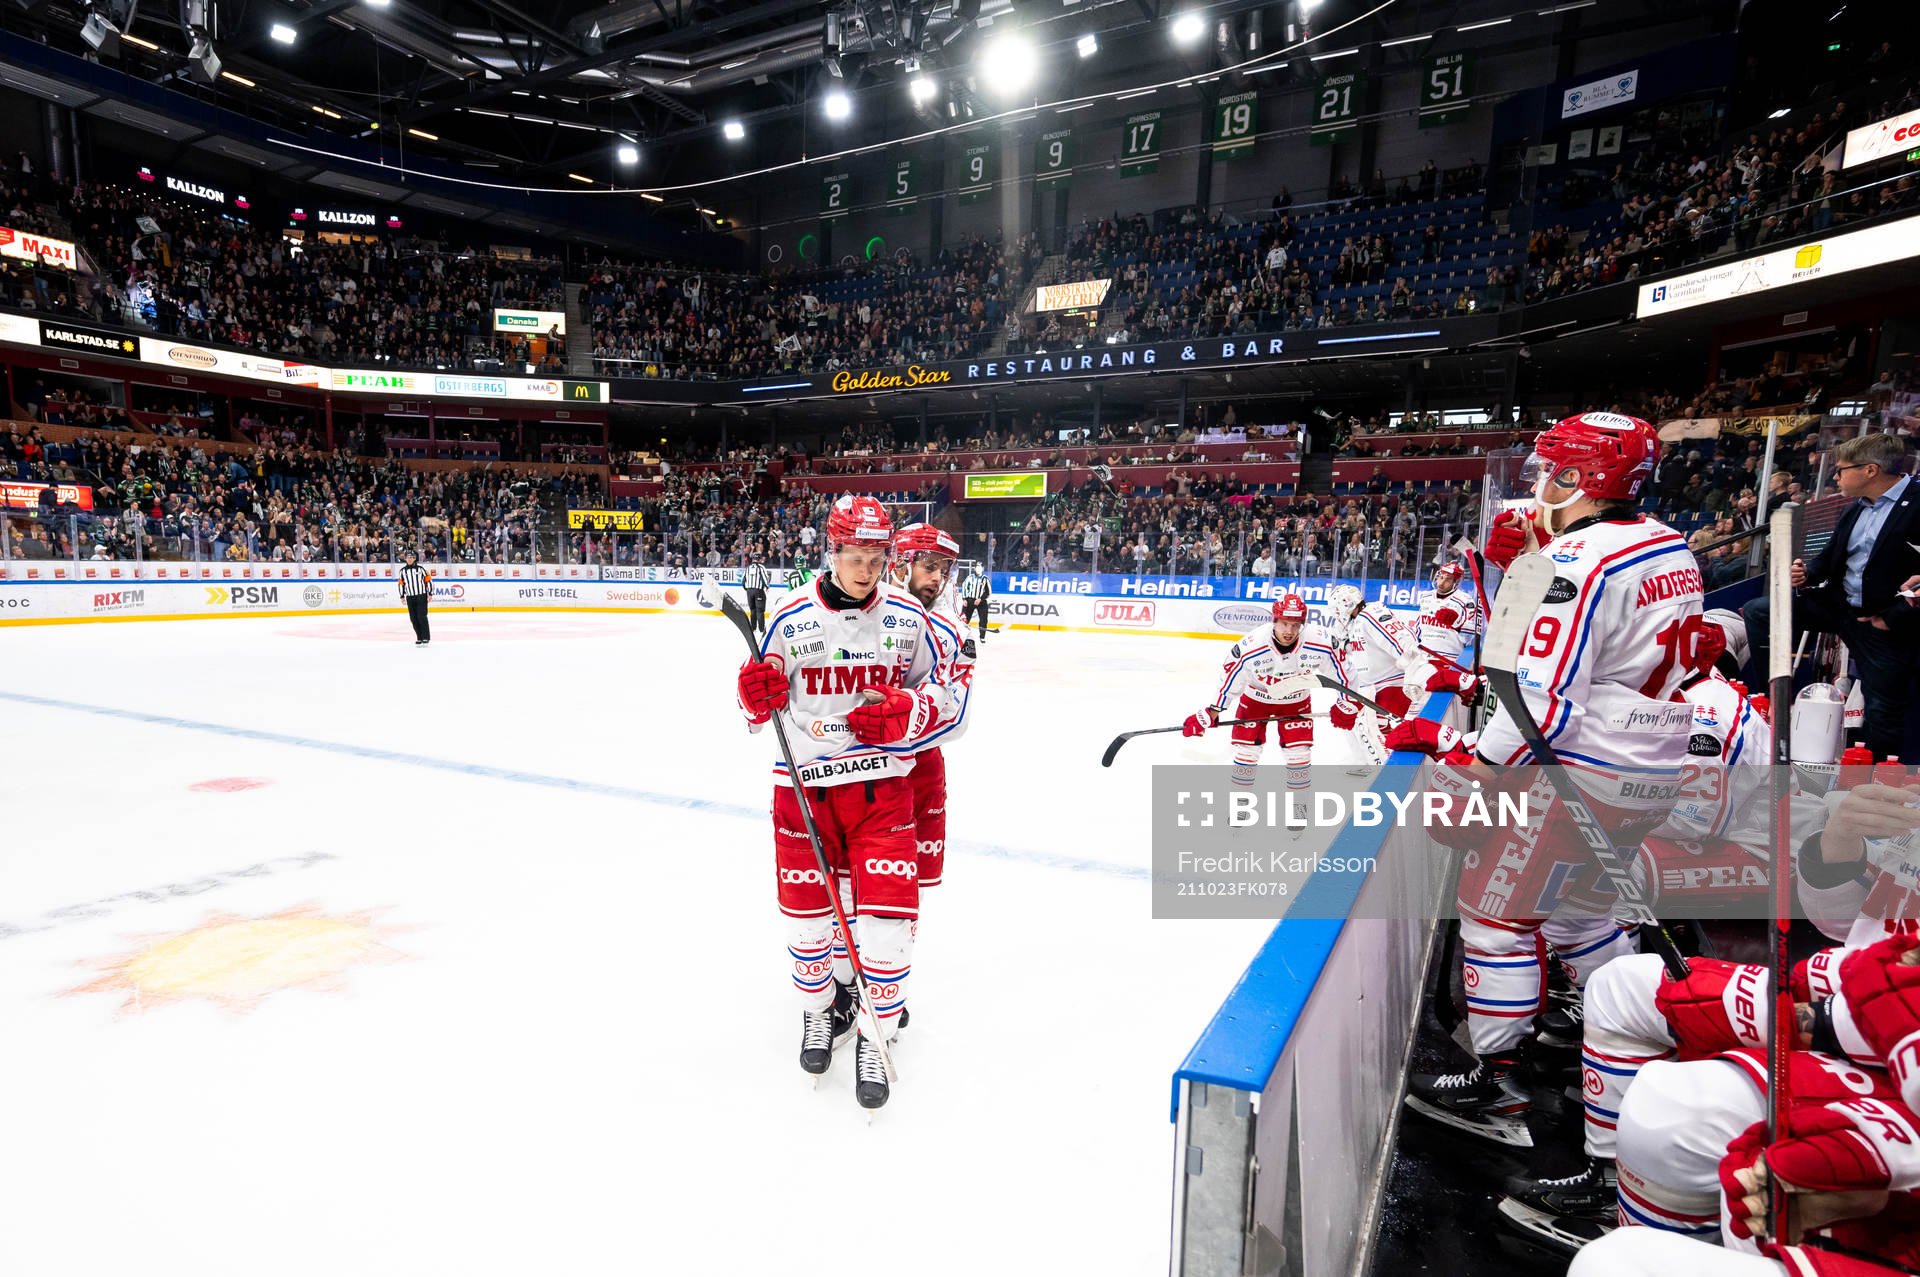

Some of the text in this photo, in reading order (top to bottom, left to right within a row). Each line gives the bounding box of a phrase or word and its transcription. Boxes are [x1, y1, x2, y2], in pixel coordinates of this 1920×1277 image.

[1436, 53, 1463, 67] WALLIN
[1430, 65, 1463, 99] 51
[1320, 86, 1351, 119] 21
[1220, 103, 1251, 137] 19
[1128, 123, 1155, 153] 17
[1048, 141, 1063, 168] 9
[970, 157, 984, 182] 9
[166, 176, 225, 204] KALLZON
[896, 170, 910, 195] 5
[829, 183, 841, 208] 2
[318, 210, 376, 225] KALLZON
[22, 237, 70, 261] MAXI
[1044, 292, 1101, 310] PIZZERIA
[46, 329, 120, 350] KARLSTAD.SE
[832, 339, 1283, 393] Golden Star RESTAURANG & BAR
[346, 375, 404, 388] PEAB
[720, 569, 735, 581] Bil
[1009, 576, 1093, 594] Helmia
[231, 586, 279, 604] PSM
[303, 593, 323, 601] BKE
[519, 588, 578, 599] PUTS TEGEL
[606, 591, 662, 602] Swedbank
[1120, 578, 1214, 598] Helmia
[1246, 580, 1333, 601] Helmi
[987, 600, 1060, 617] ŠKODA
[1096, 605, 1152, 622] JULA
[797, 621, 821, 633] SCA
[899, 618, 918, 629] SCA
[798, 640, 826, 656] LILIUM
[851, 652, 875, 660] NHC
[1255, 690, 1302, 701] BILBAGET
[1625, 708, 1660, 731] from
[802, 755, 889, 782] BILBOLAGET
[1680, 764, 1722, 802] 23
[778, 827, 810, 839] BAUER
[866, 857, 918, 881] coop
[1563, 799, 1660, 927] BAUER
[1683, 864, 1771, 889] PEA
